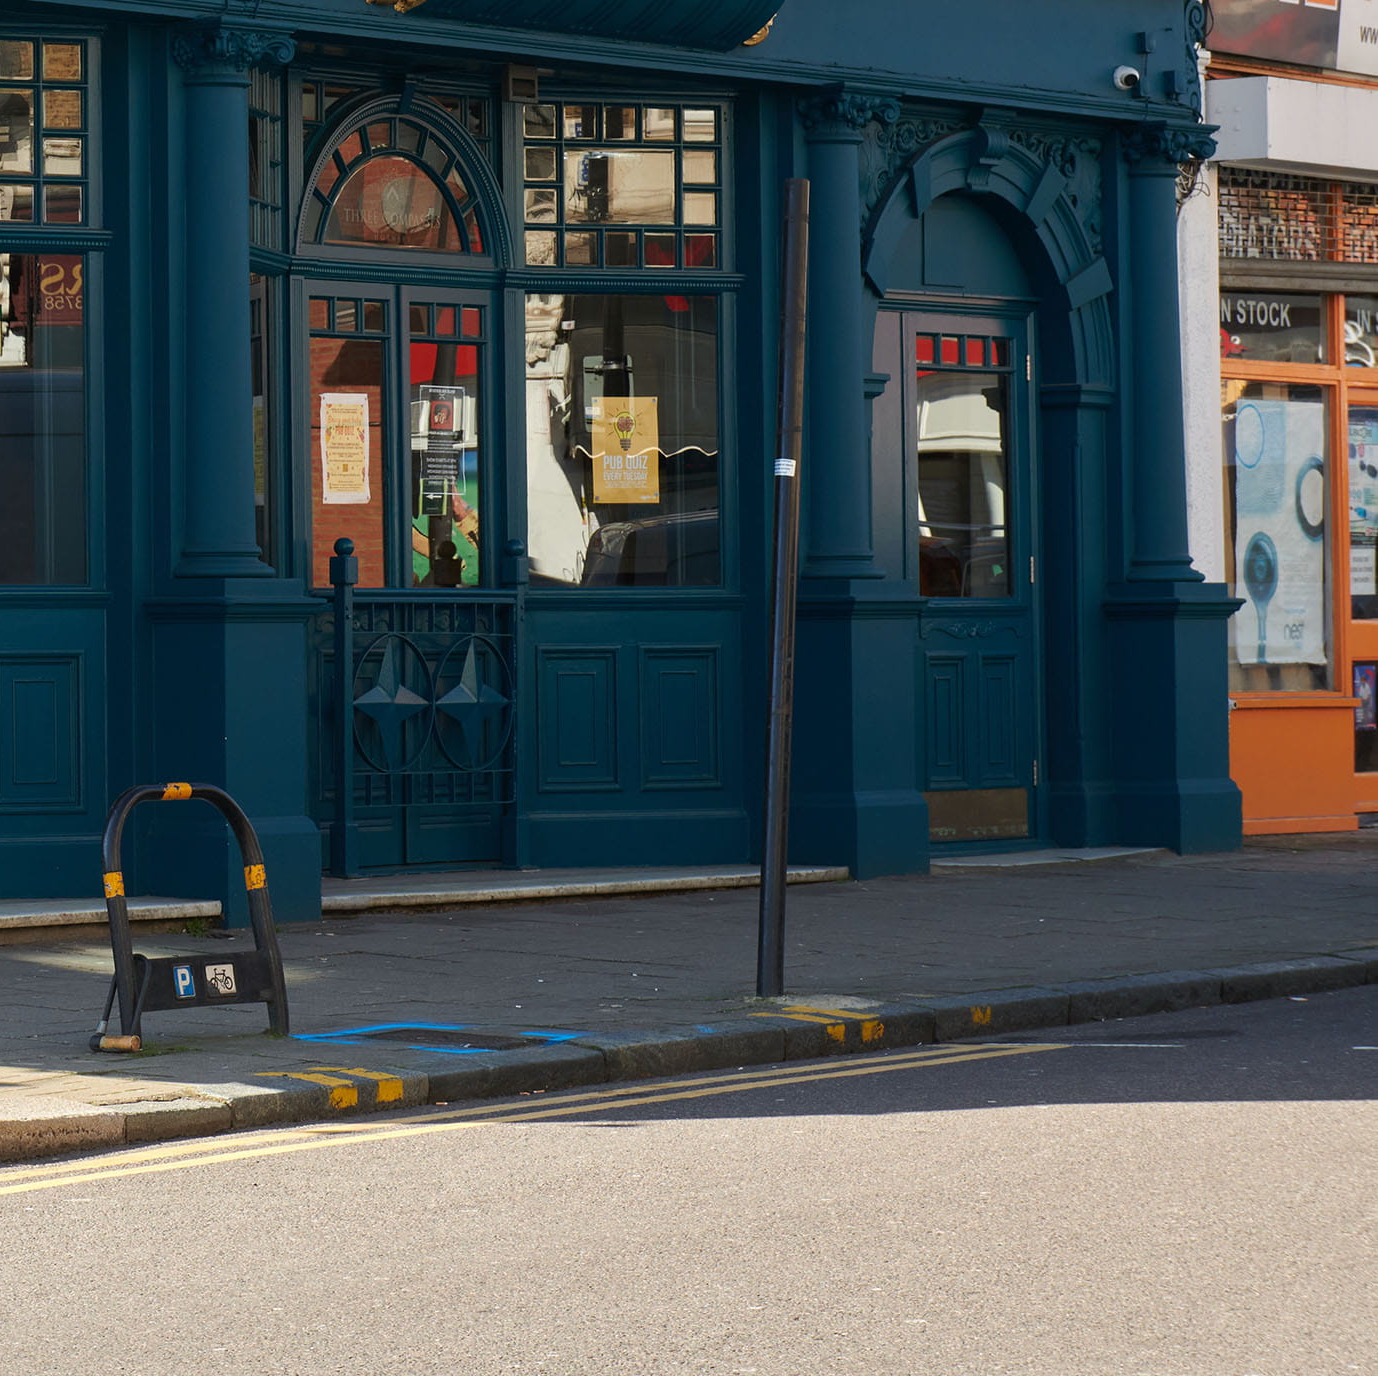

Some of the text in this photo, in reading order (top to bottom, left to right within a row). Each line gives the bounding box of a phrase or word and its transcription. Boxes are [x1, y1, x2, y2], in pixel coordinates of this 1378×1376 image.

[1237, 299, 1291, 328] STOCK
[603, 455, 648, 469] PUB QUIZ
